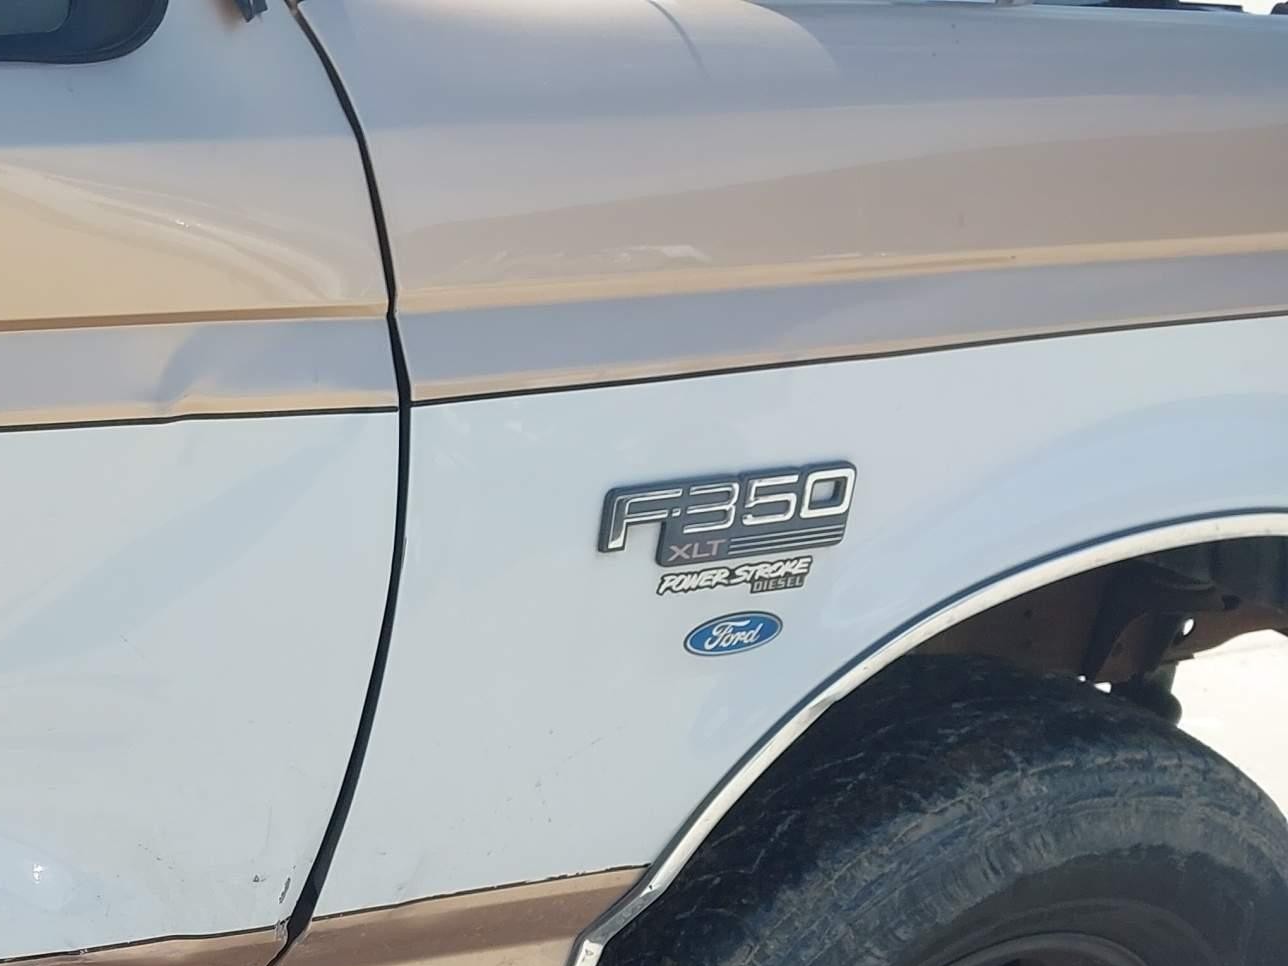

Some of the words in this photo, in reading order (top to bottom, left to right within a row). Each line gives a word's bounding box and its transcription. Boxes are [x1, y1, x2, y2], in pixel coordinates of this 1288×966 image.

[668, 538, 727, 562] XLT
[659, 568, 729, 595] POWER
[731, 557, 811, 585] STROKE
[751, 577, 804, 593] DIESEL
[703, 619, 764, 650] Ford
